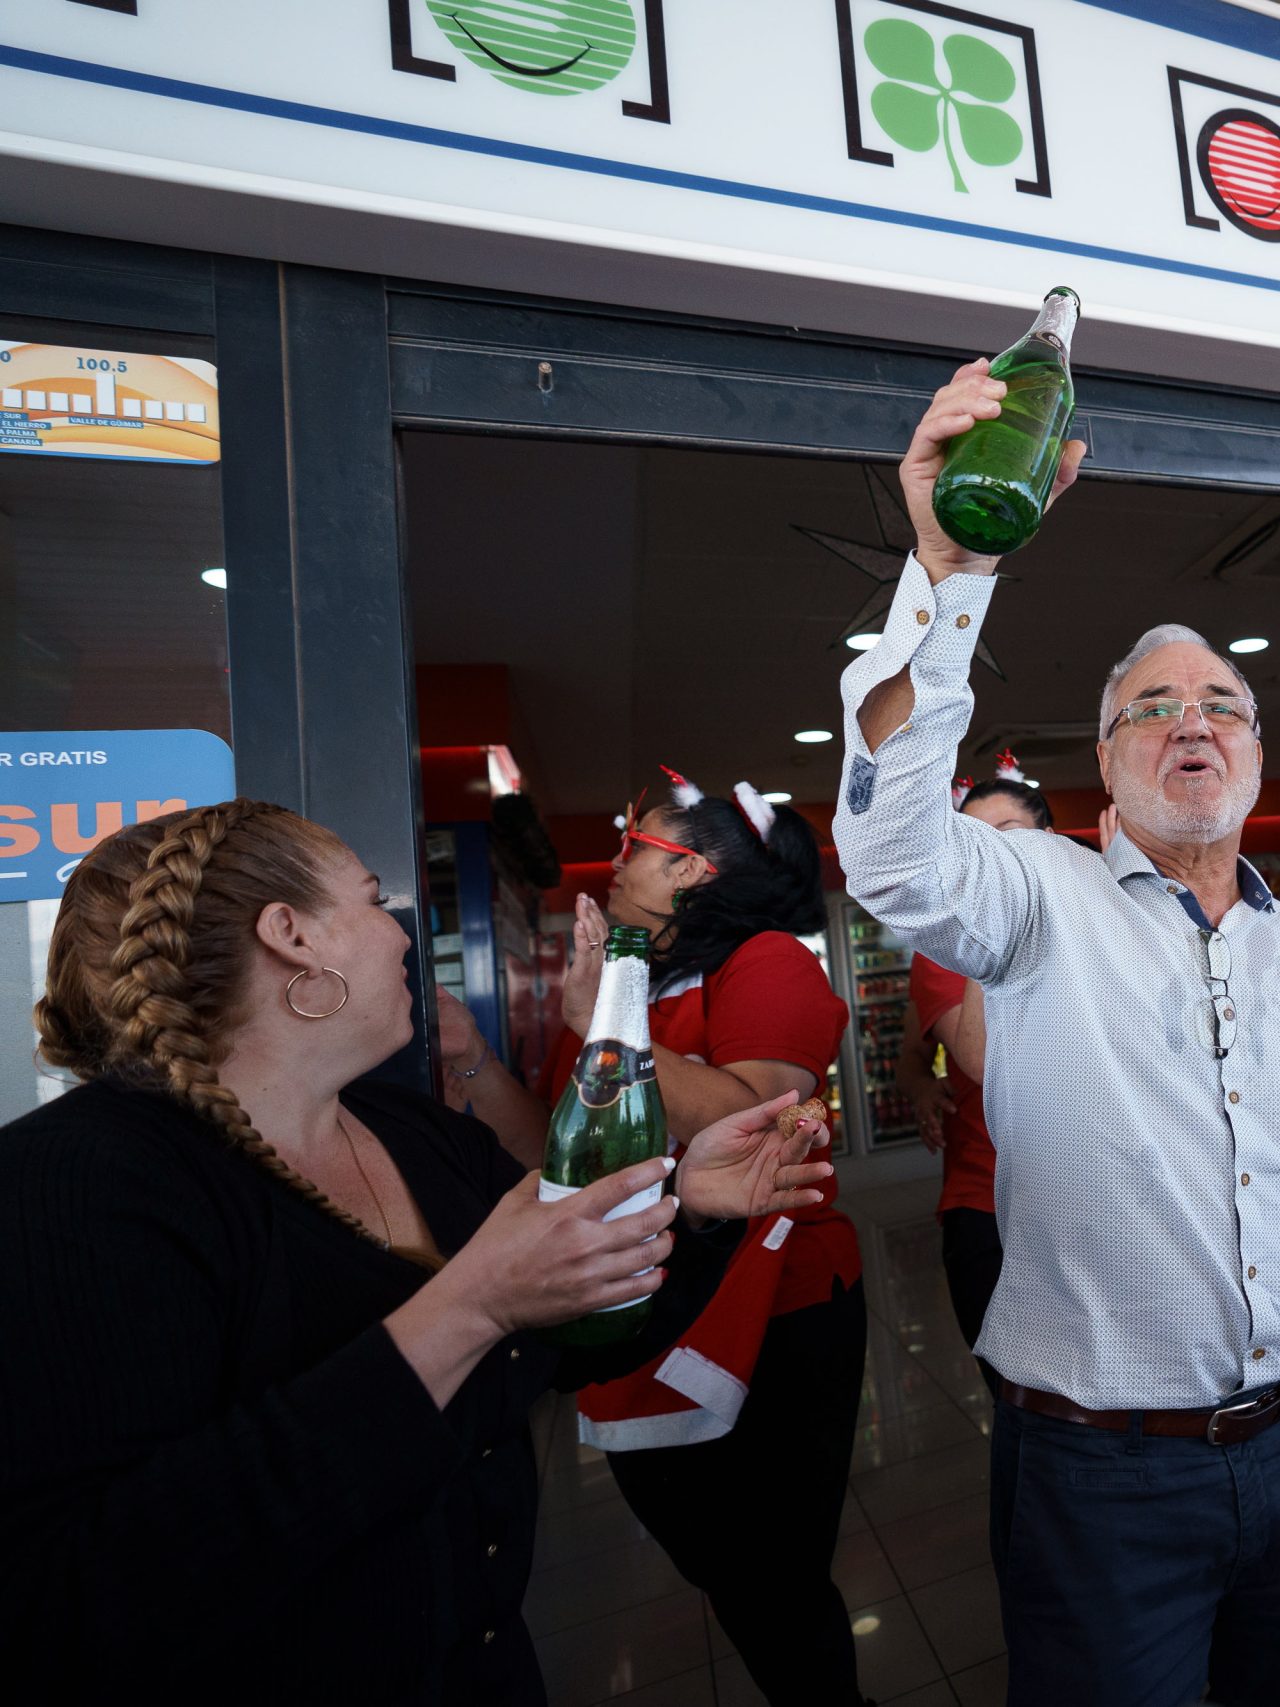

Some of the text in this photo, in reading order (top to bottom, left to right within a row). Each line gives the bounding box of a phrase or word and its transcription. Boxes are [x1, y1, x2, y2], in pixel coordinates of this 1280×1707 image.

[76, 357, 128, 373] 100.5
[70, 417, 95, 425] VALLE
[7, 429, 36, 437] PALMA
[2, 437, 40, 446] CANARIA
[20, 750, 108, 766] GRATIS
